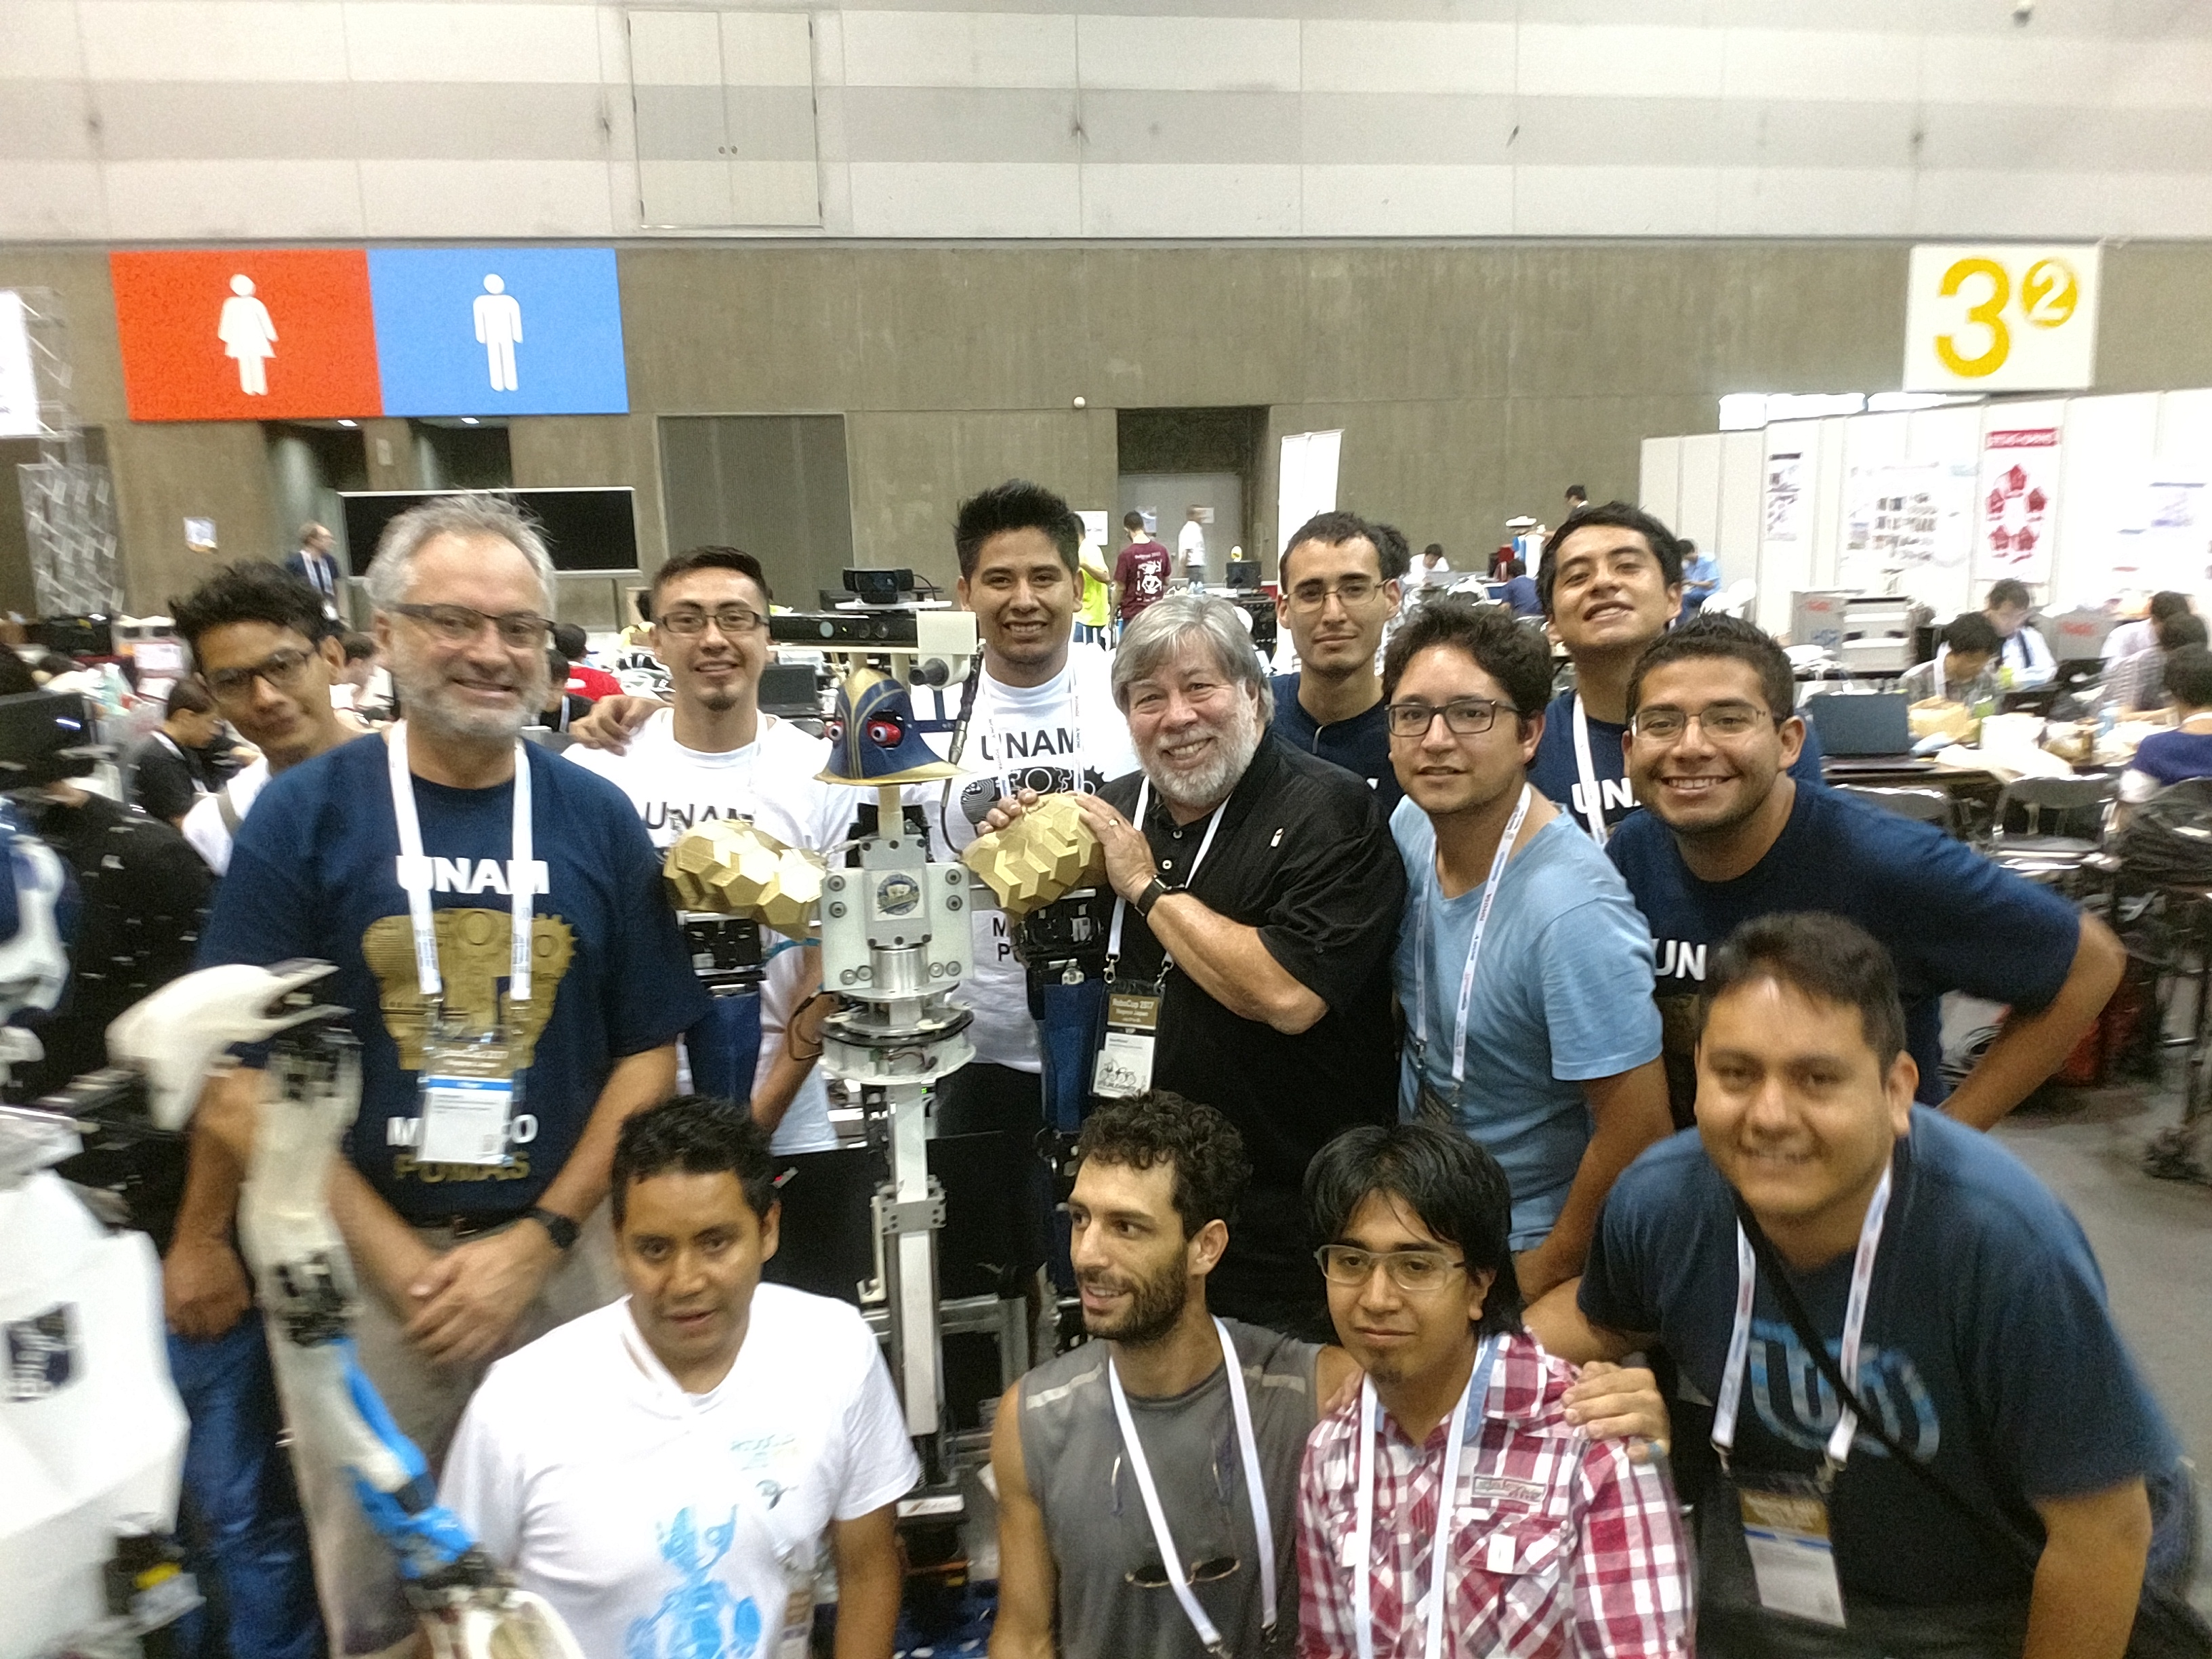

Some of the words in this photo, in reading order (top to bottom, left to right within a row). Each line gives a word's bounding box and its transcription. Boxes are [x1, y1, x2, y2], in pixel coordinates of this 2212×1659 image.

[1936, 258, 2010, 377] 3
[2026, 260, 2071, 321] 2
[1571, 777, 1643, 814] UN
[1651, 938, 1708, 981] UN
